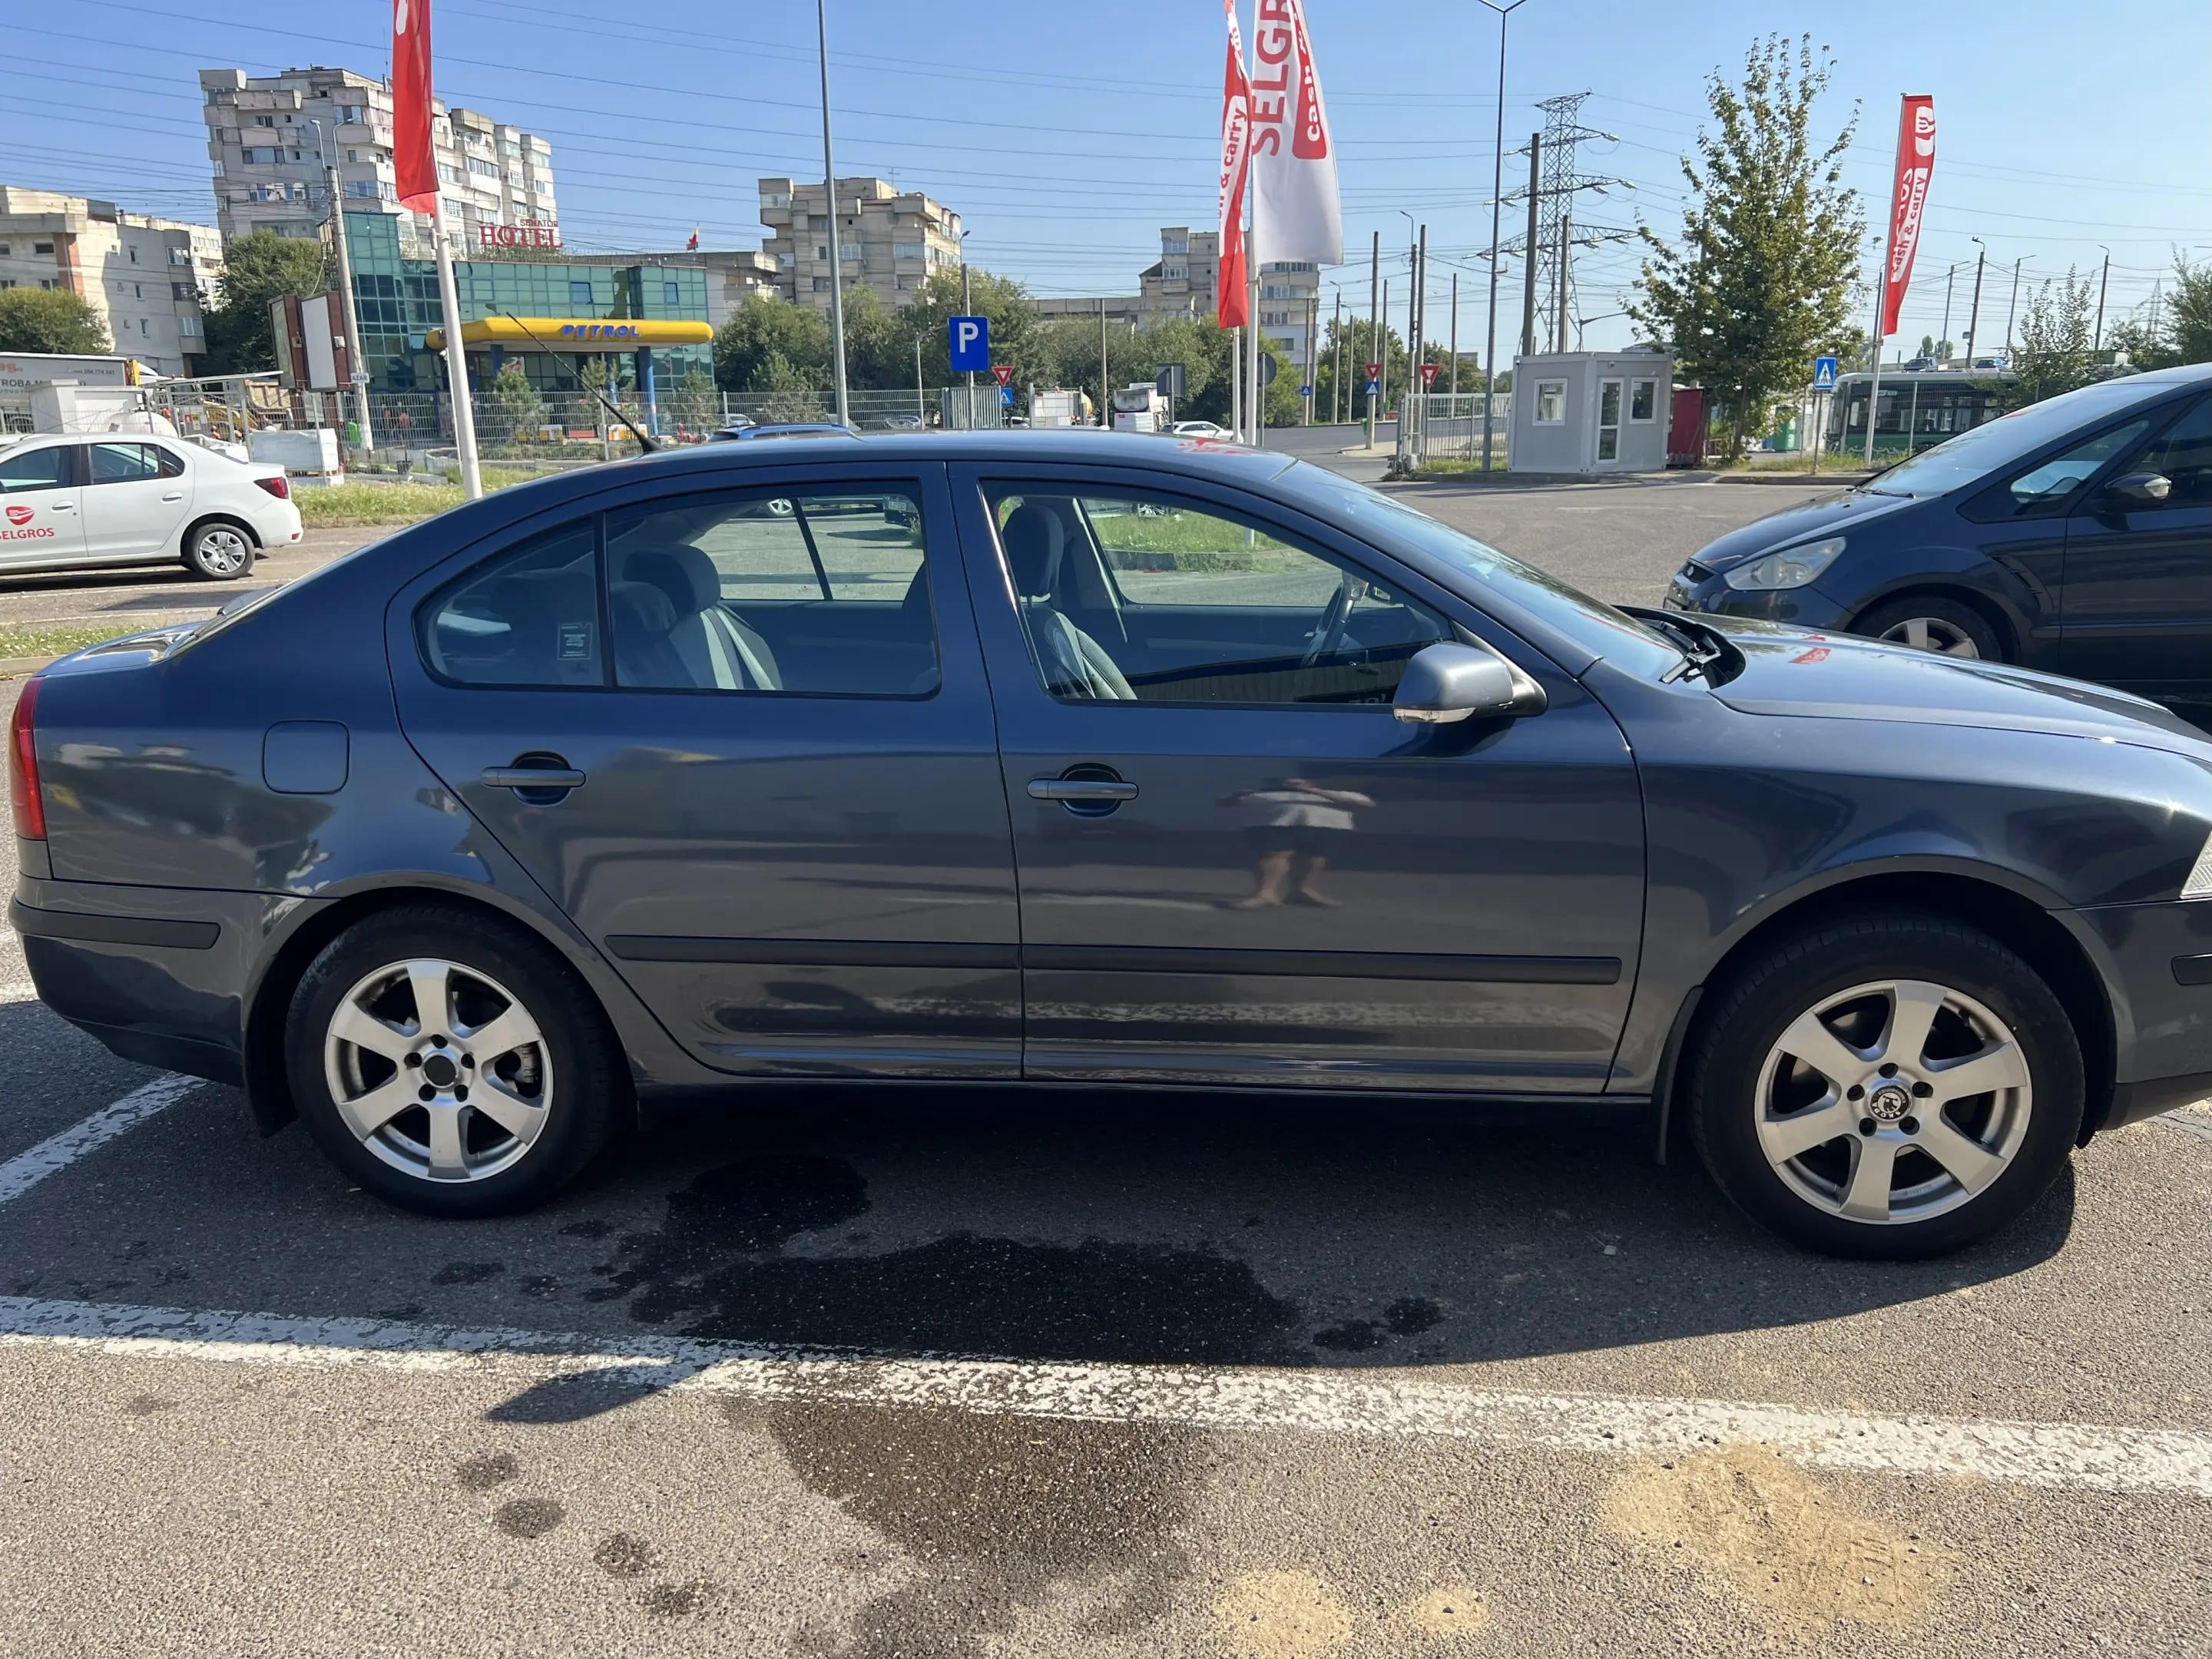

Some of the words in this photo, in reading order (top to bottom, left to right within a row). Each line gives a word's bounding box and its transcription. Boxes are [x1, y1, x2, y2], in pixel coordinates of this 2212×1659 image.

[1224, 108, 1248, 167] carry
[1904, 224, 1915, 236] &
[1910, 176, 1927, 220] carry
[519, 218, 558, 227] SENATOR
[478, 225, 564, 248] HOTEL
[562, 324, 640, 338] PETROL
[959, 322, 979, 353] P
[0, 528, 55, 540] ELGROS
